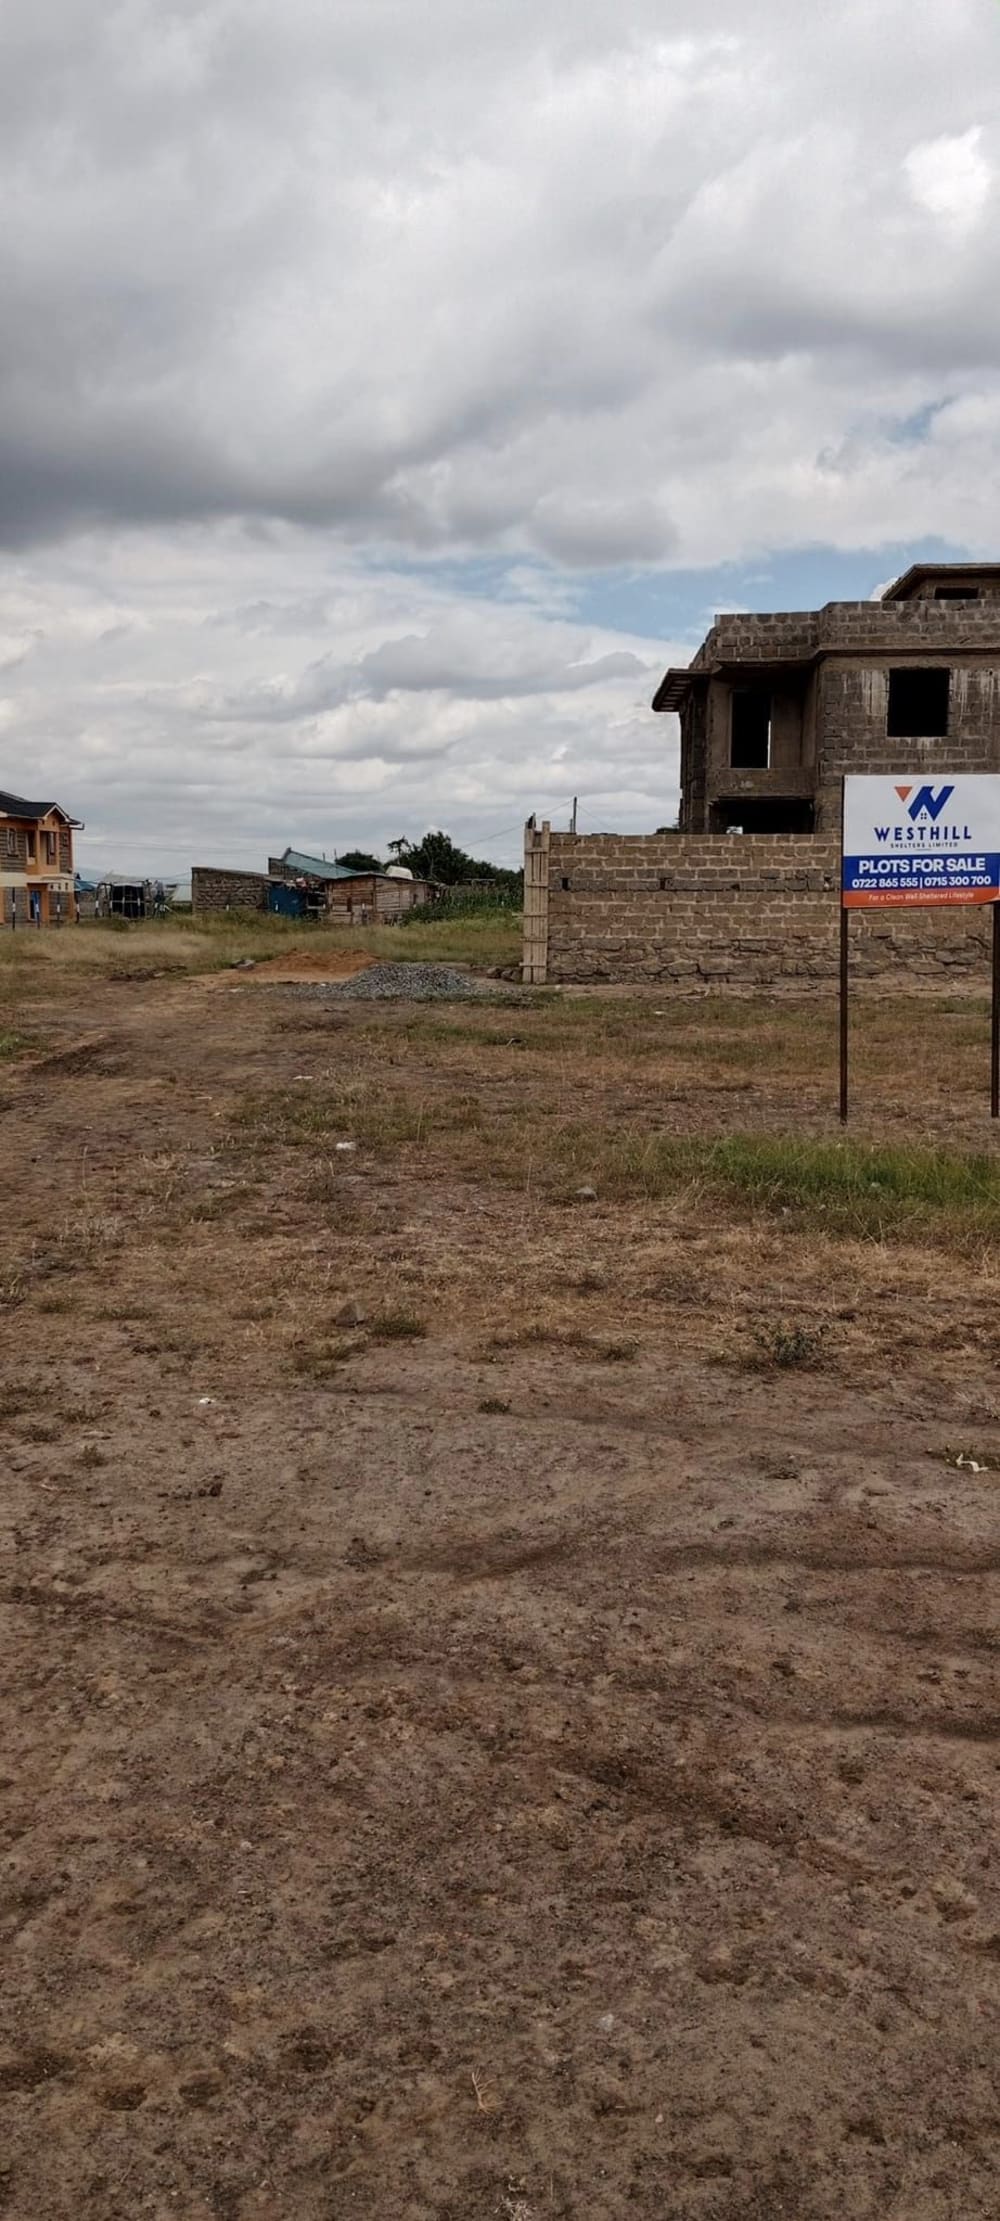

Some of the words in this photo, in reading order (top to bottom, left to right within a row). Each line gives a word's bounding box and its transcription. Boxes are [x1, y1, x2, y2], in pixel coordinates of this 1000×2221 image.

[874, 825, 972, 841] WESTHILL
[859, 859, 910, 874] PLOTS
[912, 858, 943, 873] FOR
[946, 857, 986, 872] SALE
[852, 878, 877, 888] 0722
[879, 877, 898, 888] 865
[900, 877, 918, 887] 555
[924, 876, 947, 887] 0715
[949, 876, 970, 886] 300
[971, 875, 991, 885] 700
[886, 893, 903, 901] Clean
[919, 892, 948, 900] Sheltered
[949, 892, 974, 900] Lifestyle
